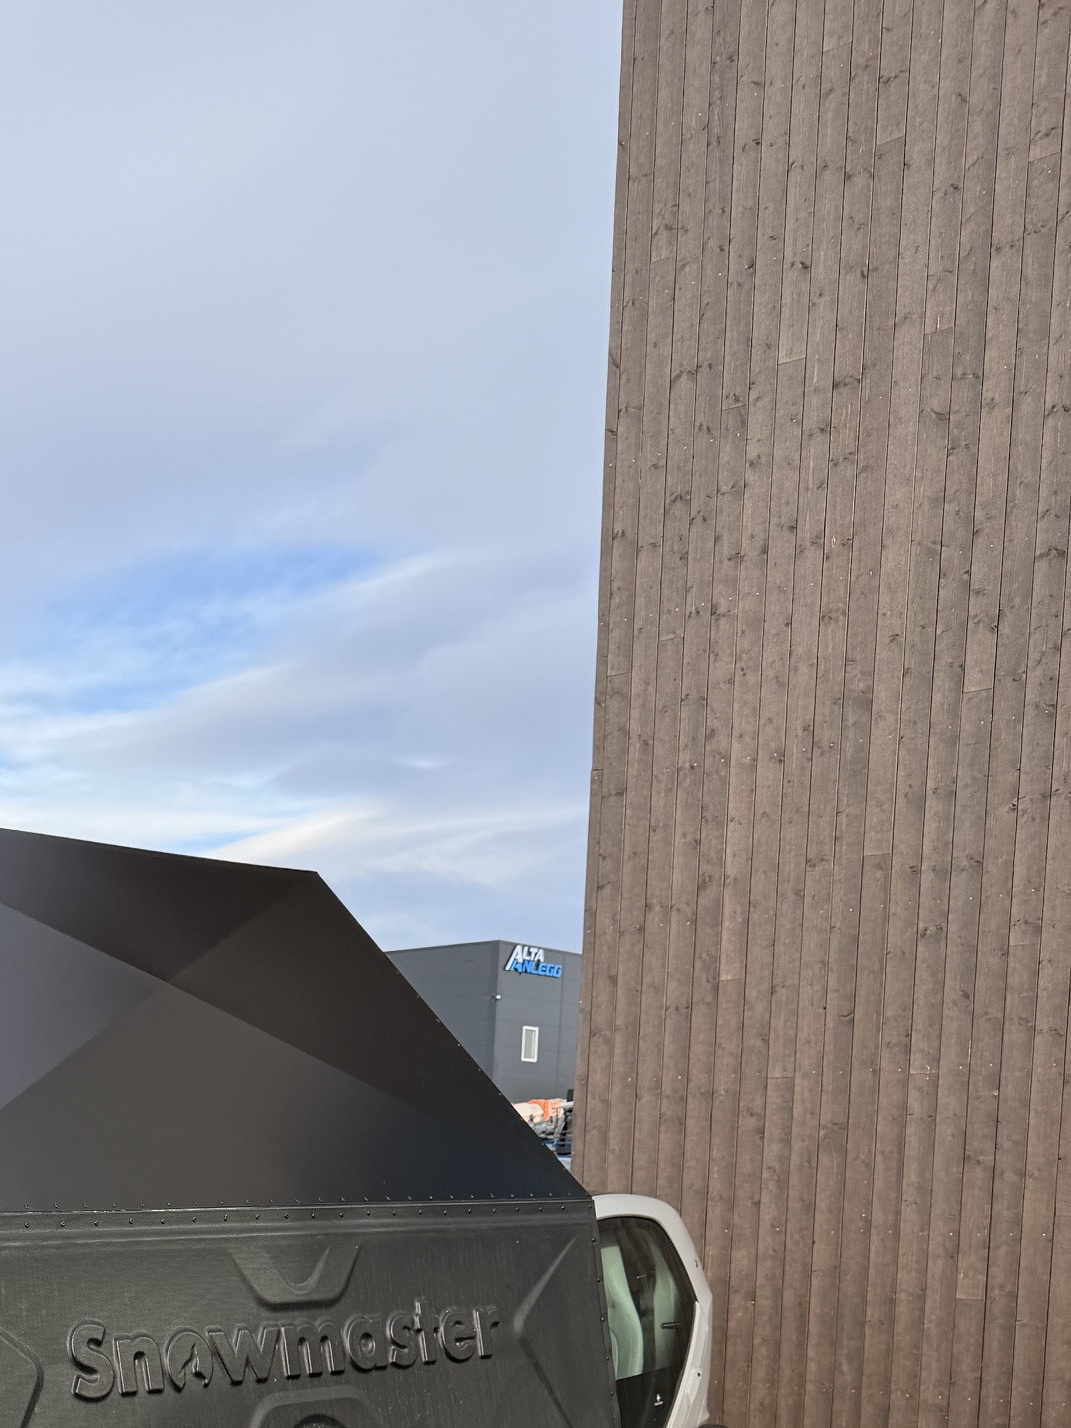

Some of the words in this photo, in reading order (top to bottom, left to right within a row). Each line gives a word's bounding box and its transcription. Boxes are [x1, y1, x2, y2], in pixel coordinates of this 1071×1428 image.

[505, 944, 544, 971] ALTA
[510, 960, 562, 978] ANLEGG
[67, 1297, 504, 1401] Snowmaster
